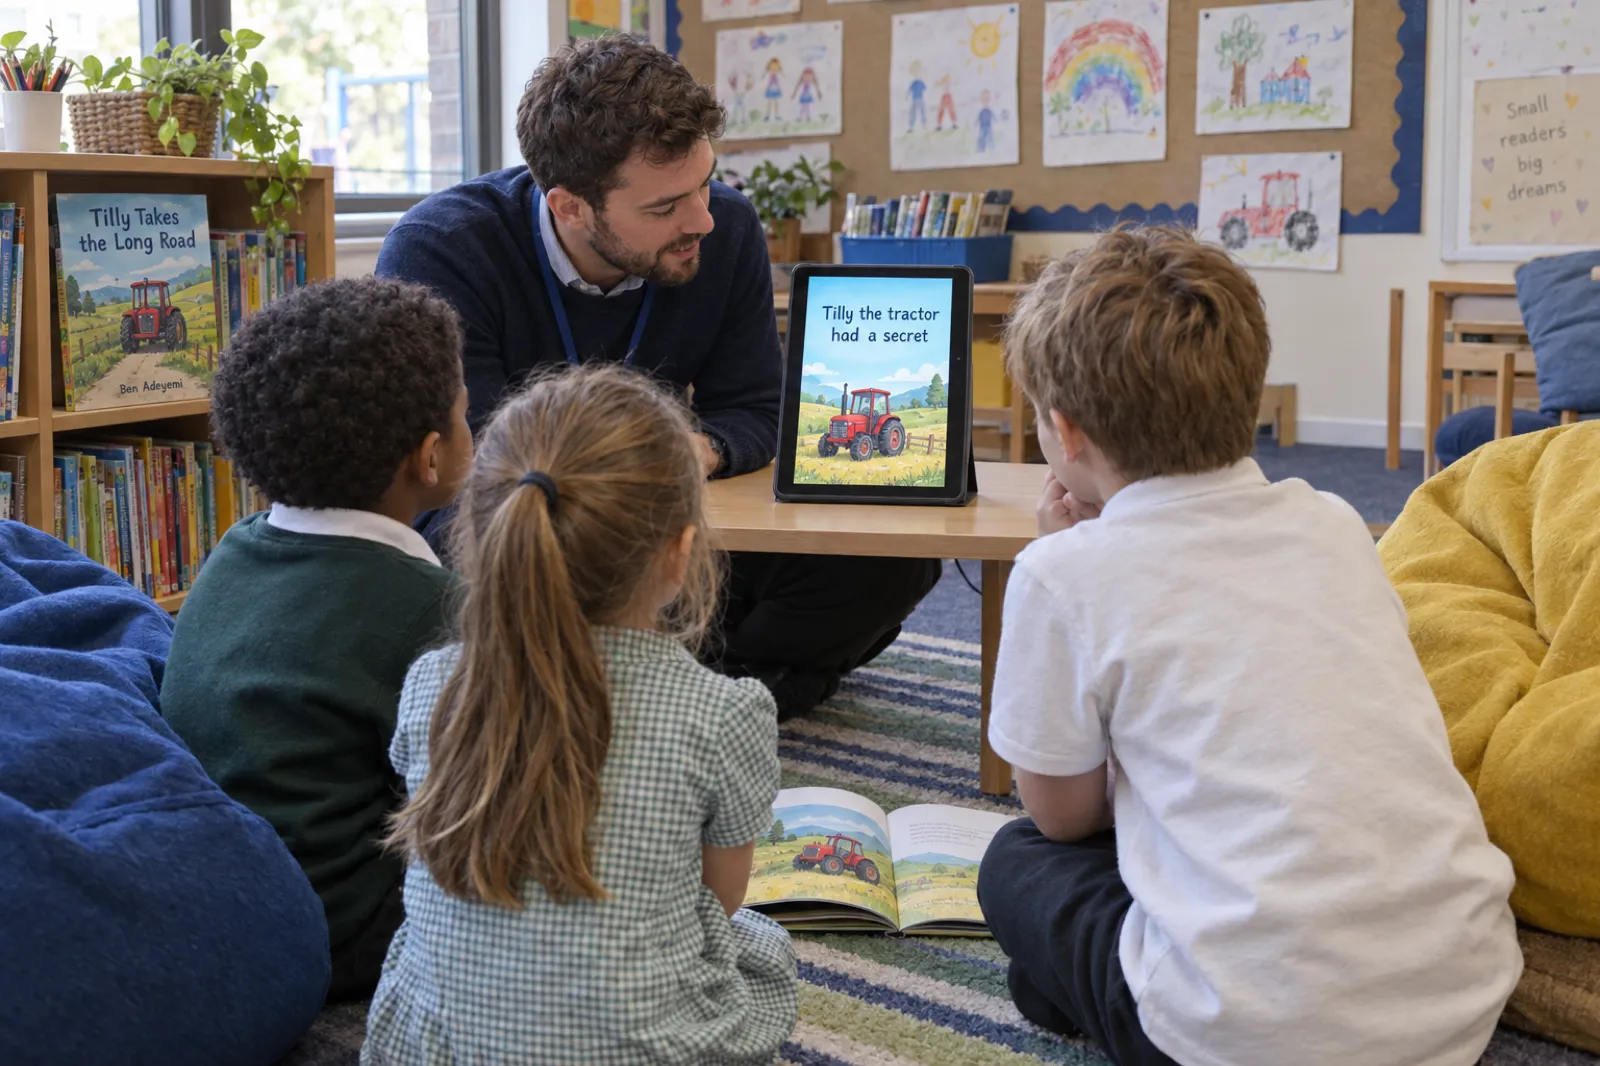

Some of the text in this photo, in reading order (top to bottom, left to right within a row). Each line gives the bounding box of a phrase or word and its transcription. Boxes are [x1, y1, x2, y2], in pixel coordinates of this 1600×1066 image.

[1506, 94, 1549, 120] Small
[1500, 125, 1567, 148] readers
[1517, 155, 1543, 175] big
[1507, 180, 1567, 201] dreams
[89, 206, 180, 231] Tilly Takes
[79, 230, 196, 255] the Long Road
[822, 305, 940, 325] Tilly the tractor
[831, 327, 928, 342] had a secret
[119, 378, 183, 394] Ben Adeyemi
